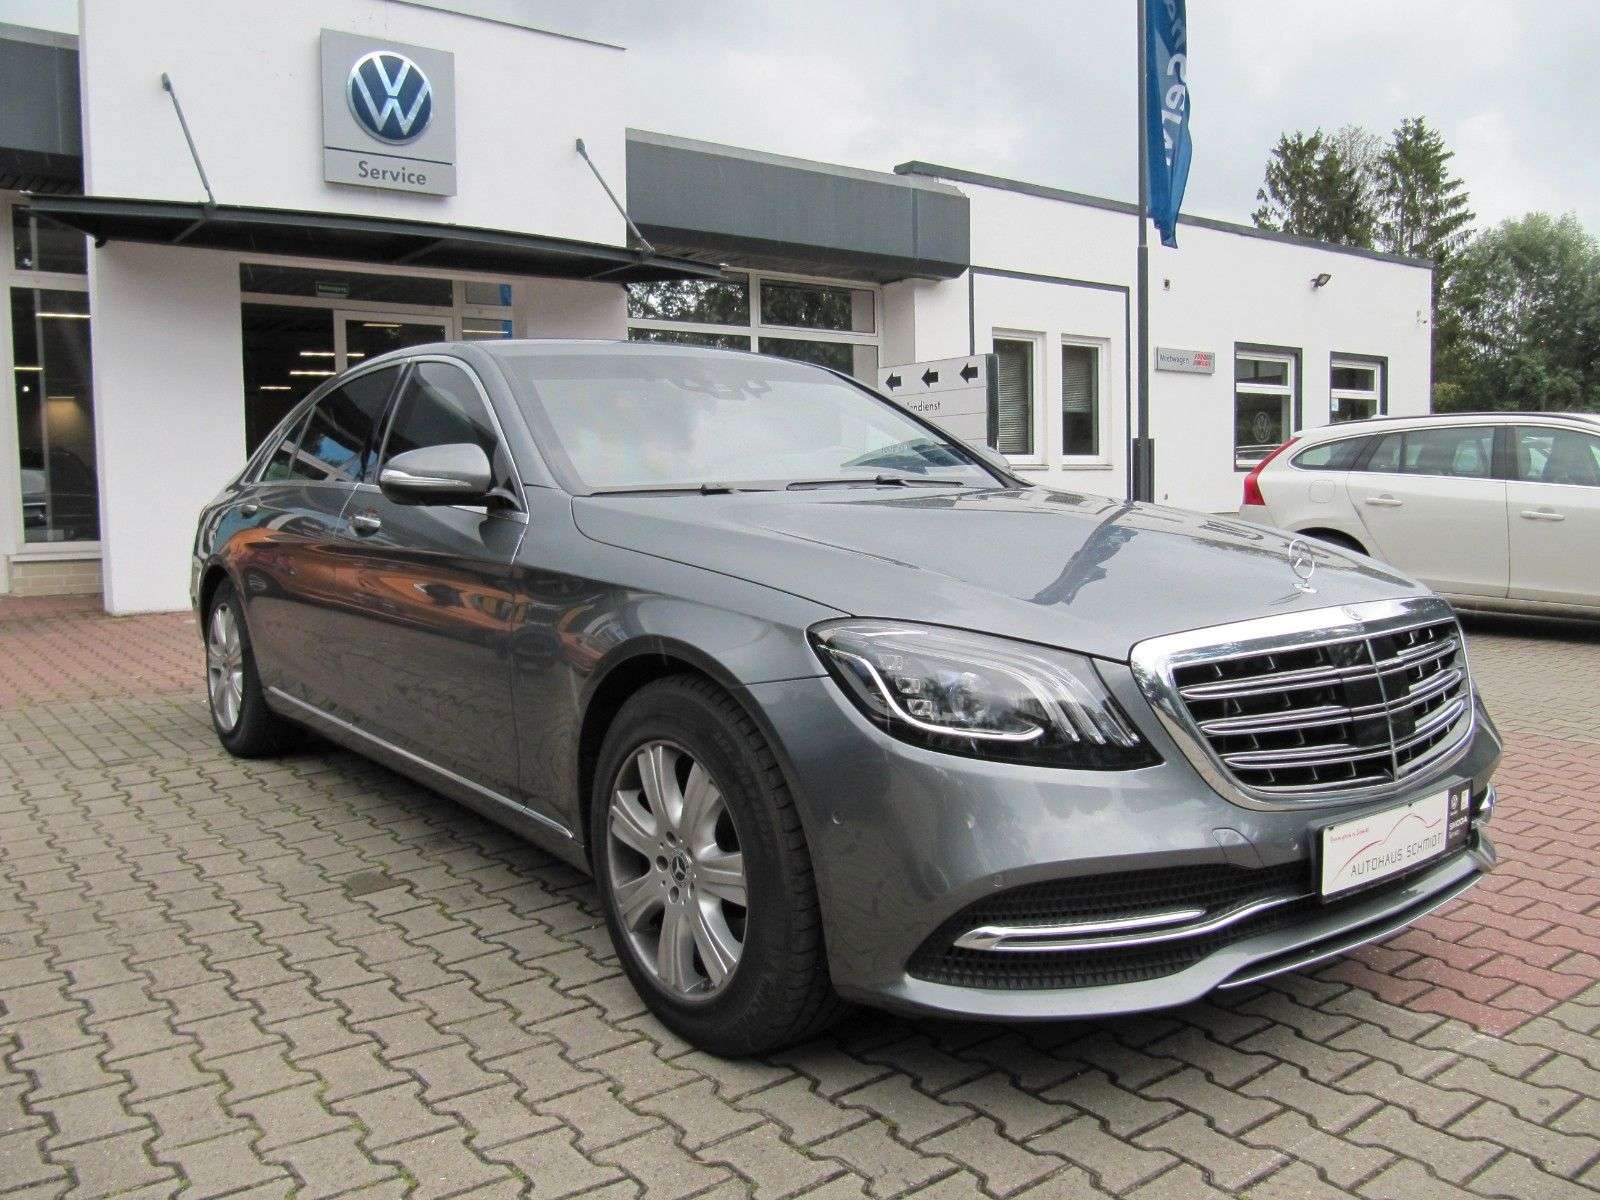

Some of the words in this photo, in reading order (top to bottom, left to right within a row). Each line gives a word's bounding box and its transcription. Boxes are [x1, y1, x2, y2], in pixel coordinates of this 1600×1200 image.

[349, 51, 431, 141] VW
[358, 160, 427, 186] Service
[908, 400, 941, 412] ndienst
[1351, 849, 1403, 877] AUTOHAUS
[1406, 833, 1442, 858] SCHMIDT
